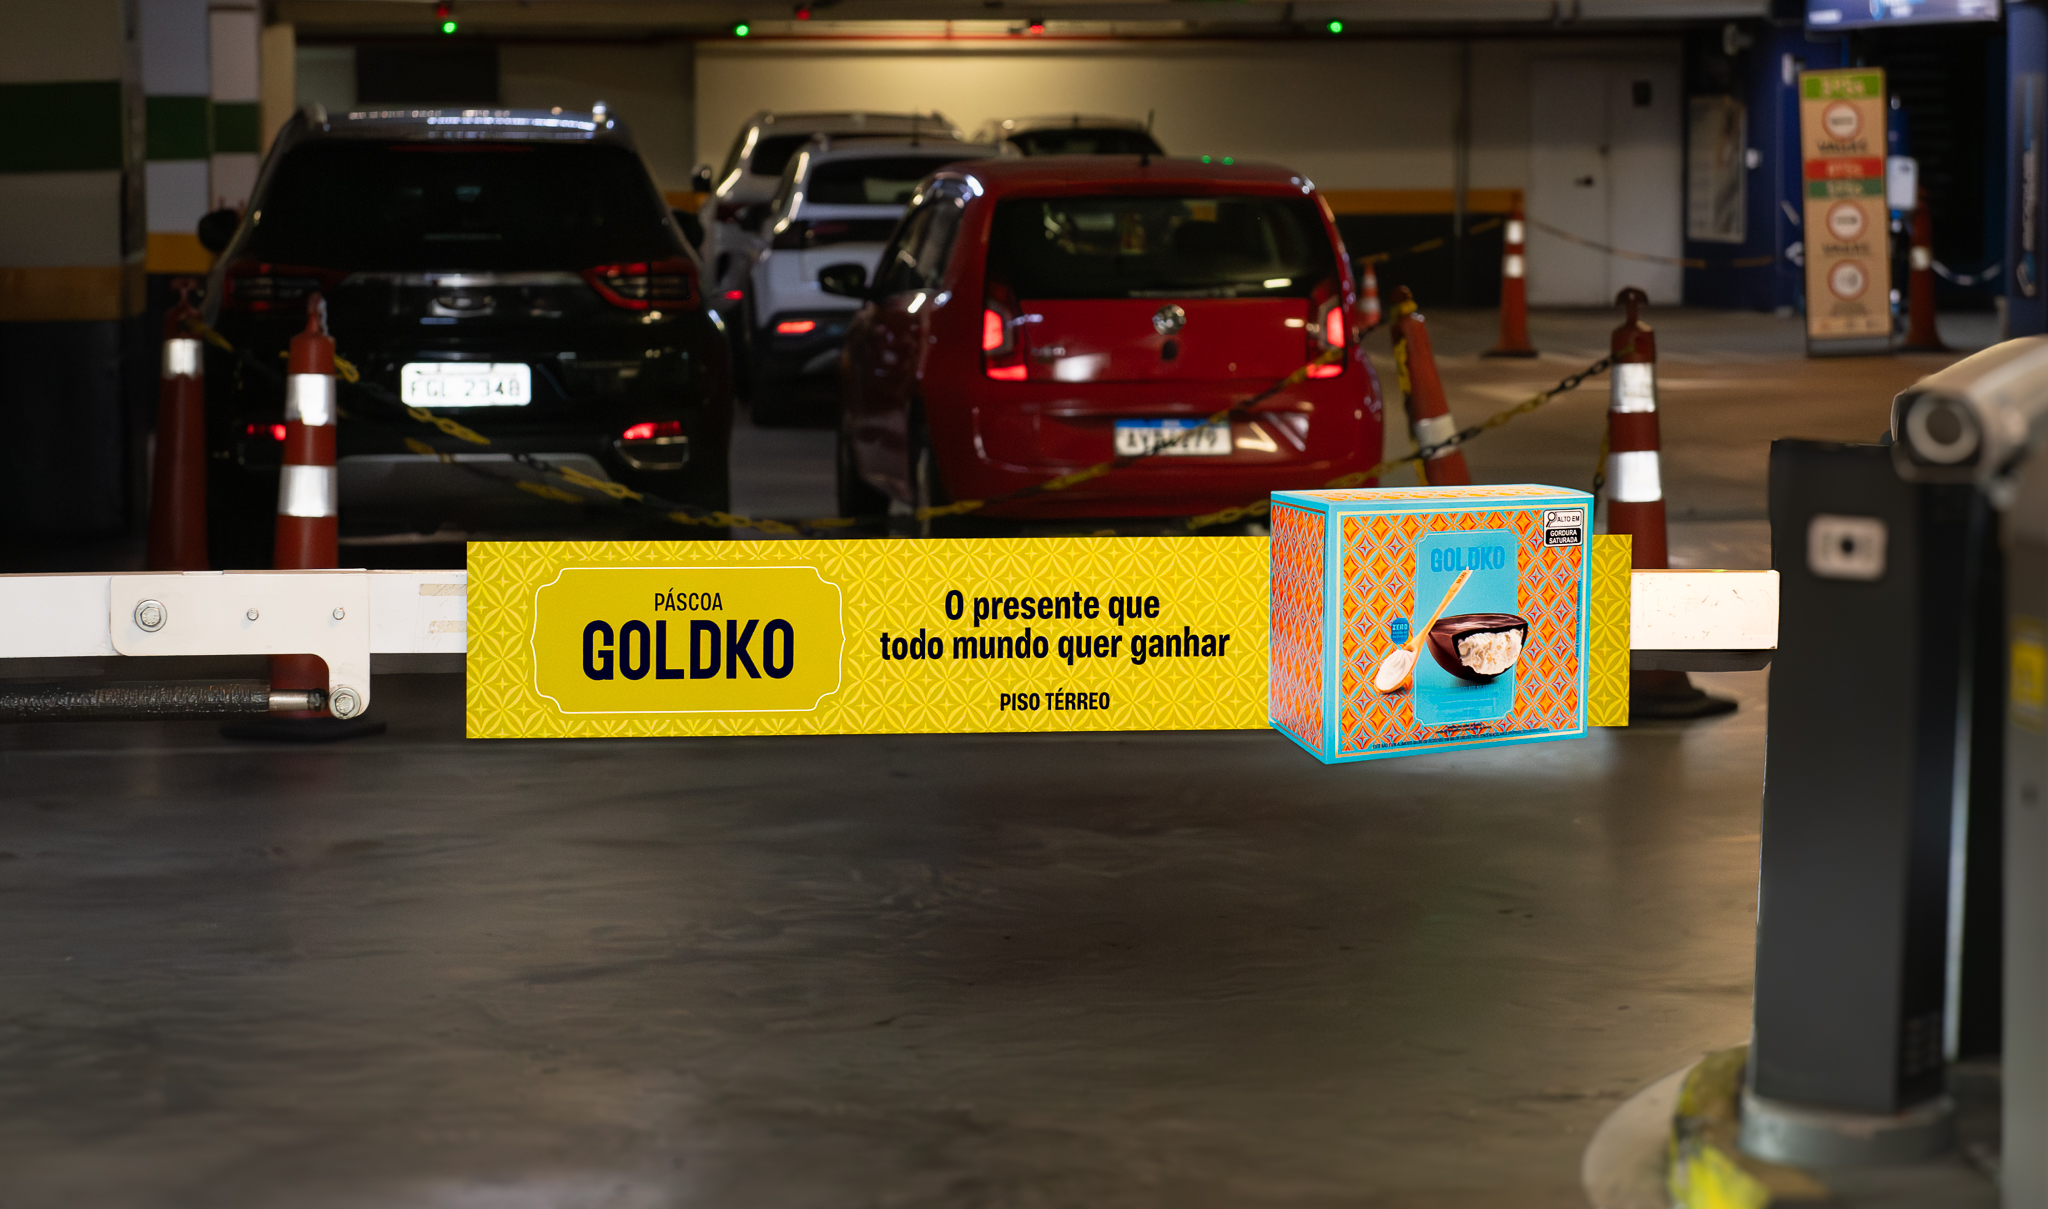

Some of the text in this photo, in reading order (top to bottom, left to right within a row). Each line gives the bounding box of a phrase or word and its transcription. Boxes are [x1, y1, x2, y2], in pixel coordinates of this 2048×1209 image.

[1550, 529, 1578, 537] GORDURA
[1431, 546, 1505, 572] GOLDKO
[654, 587, 723, 612] PÁSCOA
[944, 589, 1160, 628] O presente que
[582, 618, 794, 681] GOLDKO
[879, 625, 1231, 666] todo mundo quer ganhar
[1000, 687, 1110, 711] PISO TÉRREO
